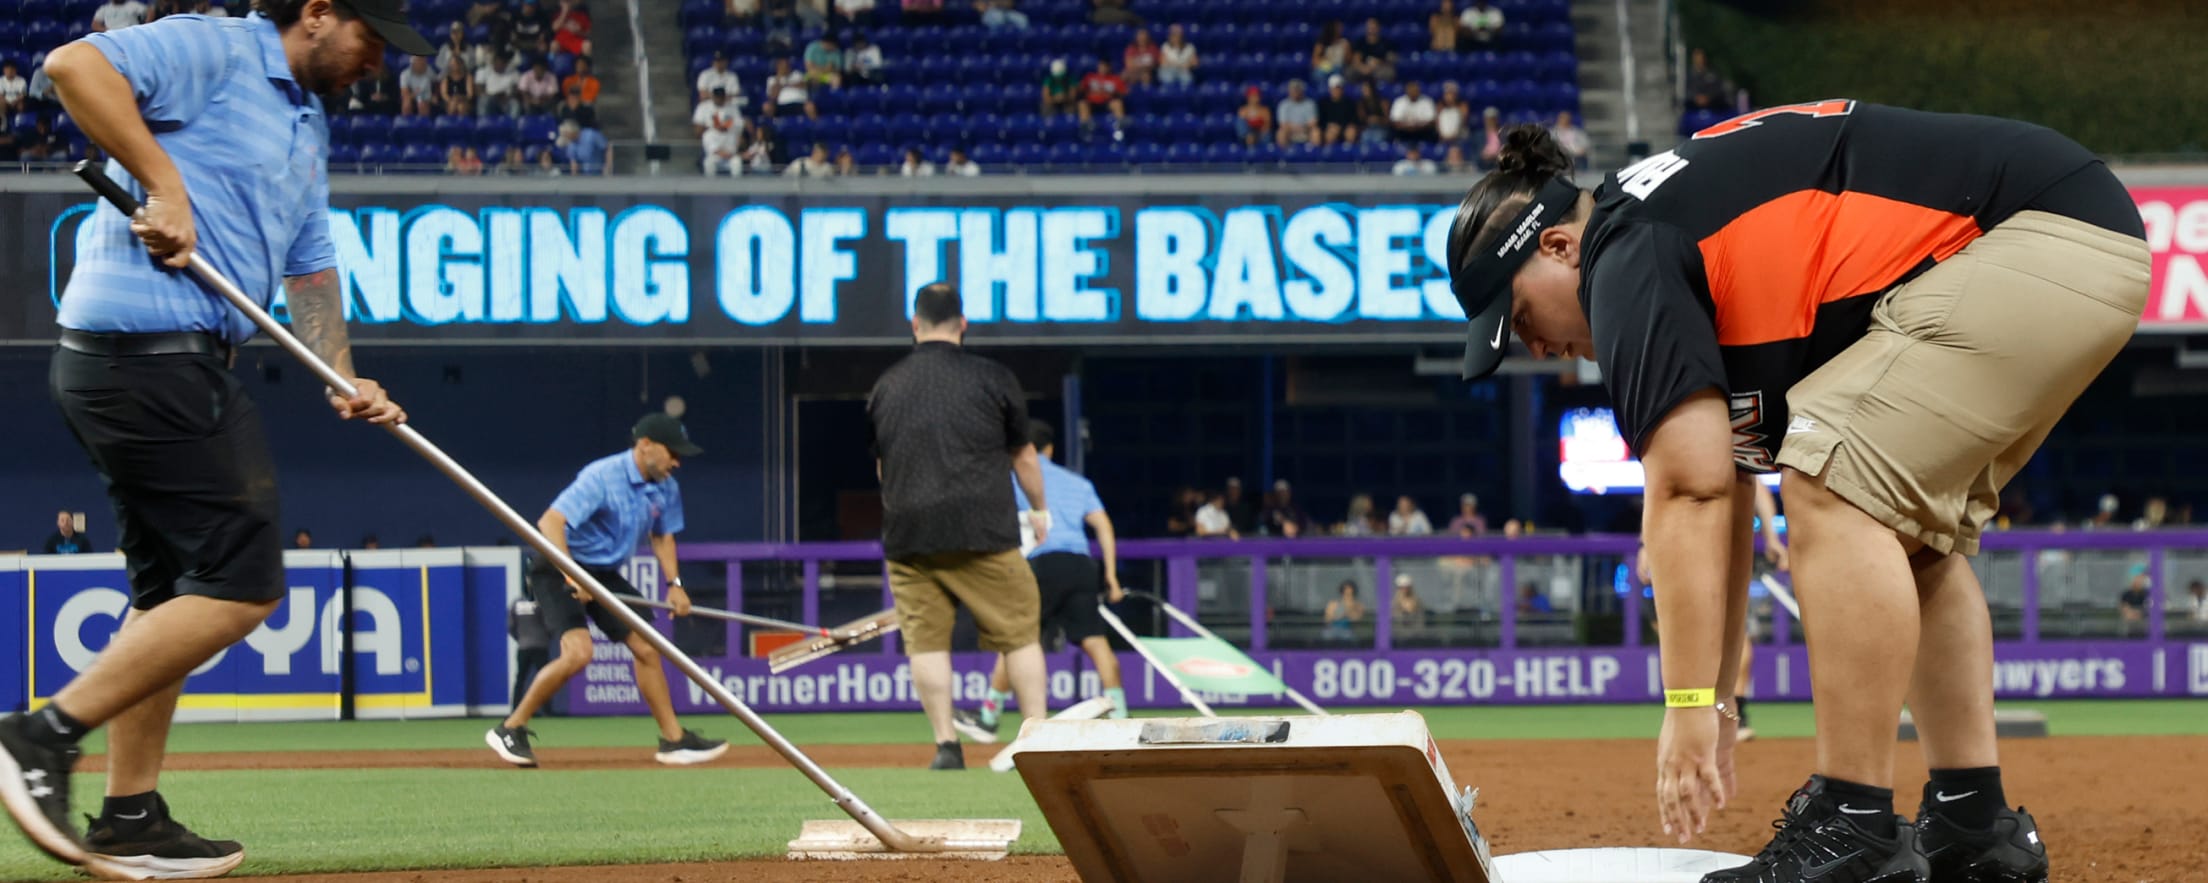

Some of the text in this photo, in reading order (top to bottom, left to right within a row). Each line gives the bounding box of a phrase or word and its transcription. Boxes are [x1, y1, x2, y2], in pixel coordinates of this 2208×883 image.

[50, 204, 691, 325] NGING
[714, 204, 868, 325] OF
[886, 206, 1120, 322] THE
[1497, 233, 1518, 258] MIAMI
[54, 586, 403, 676] GYA
[585, 684, 640, 703] GARCIA
[1312, 656, 1620, 699] 800-320-HELP
